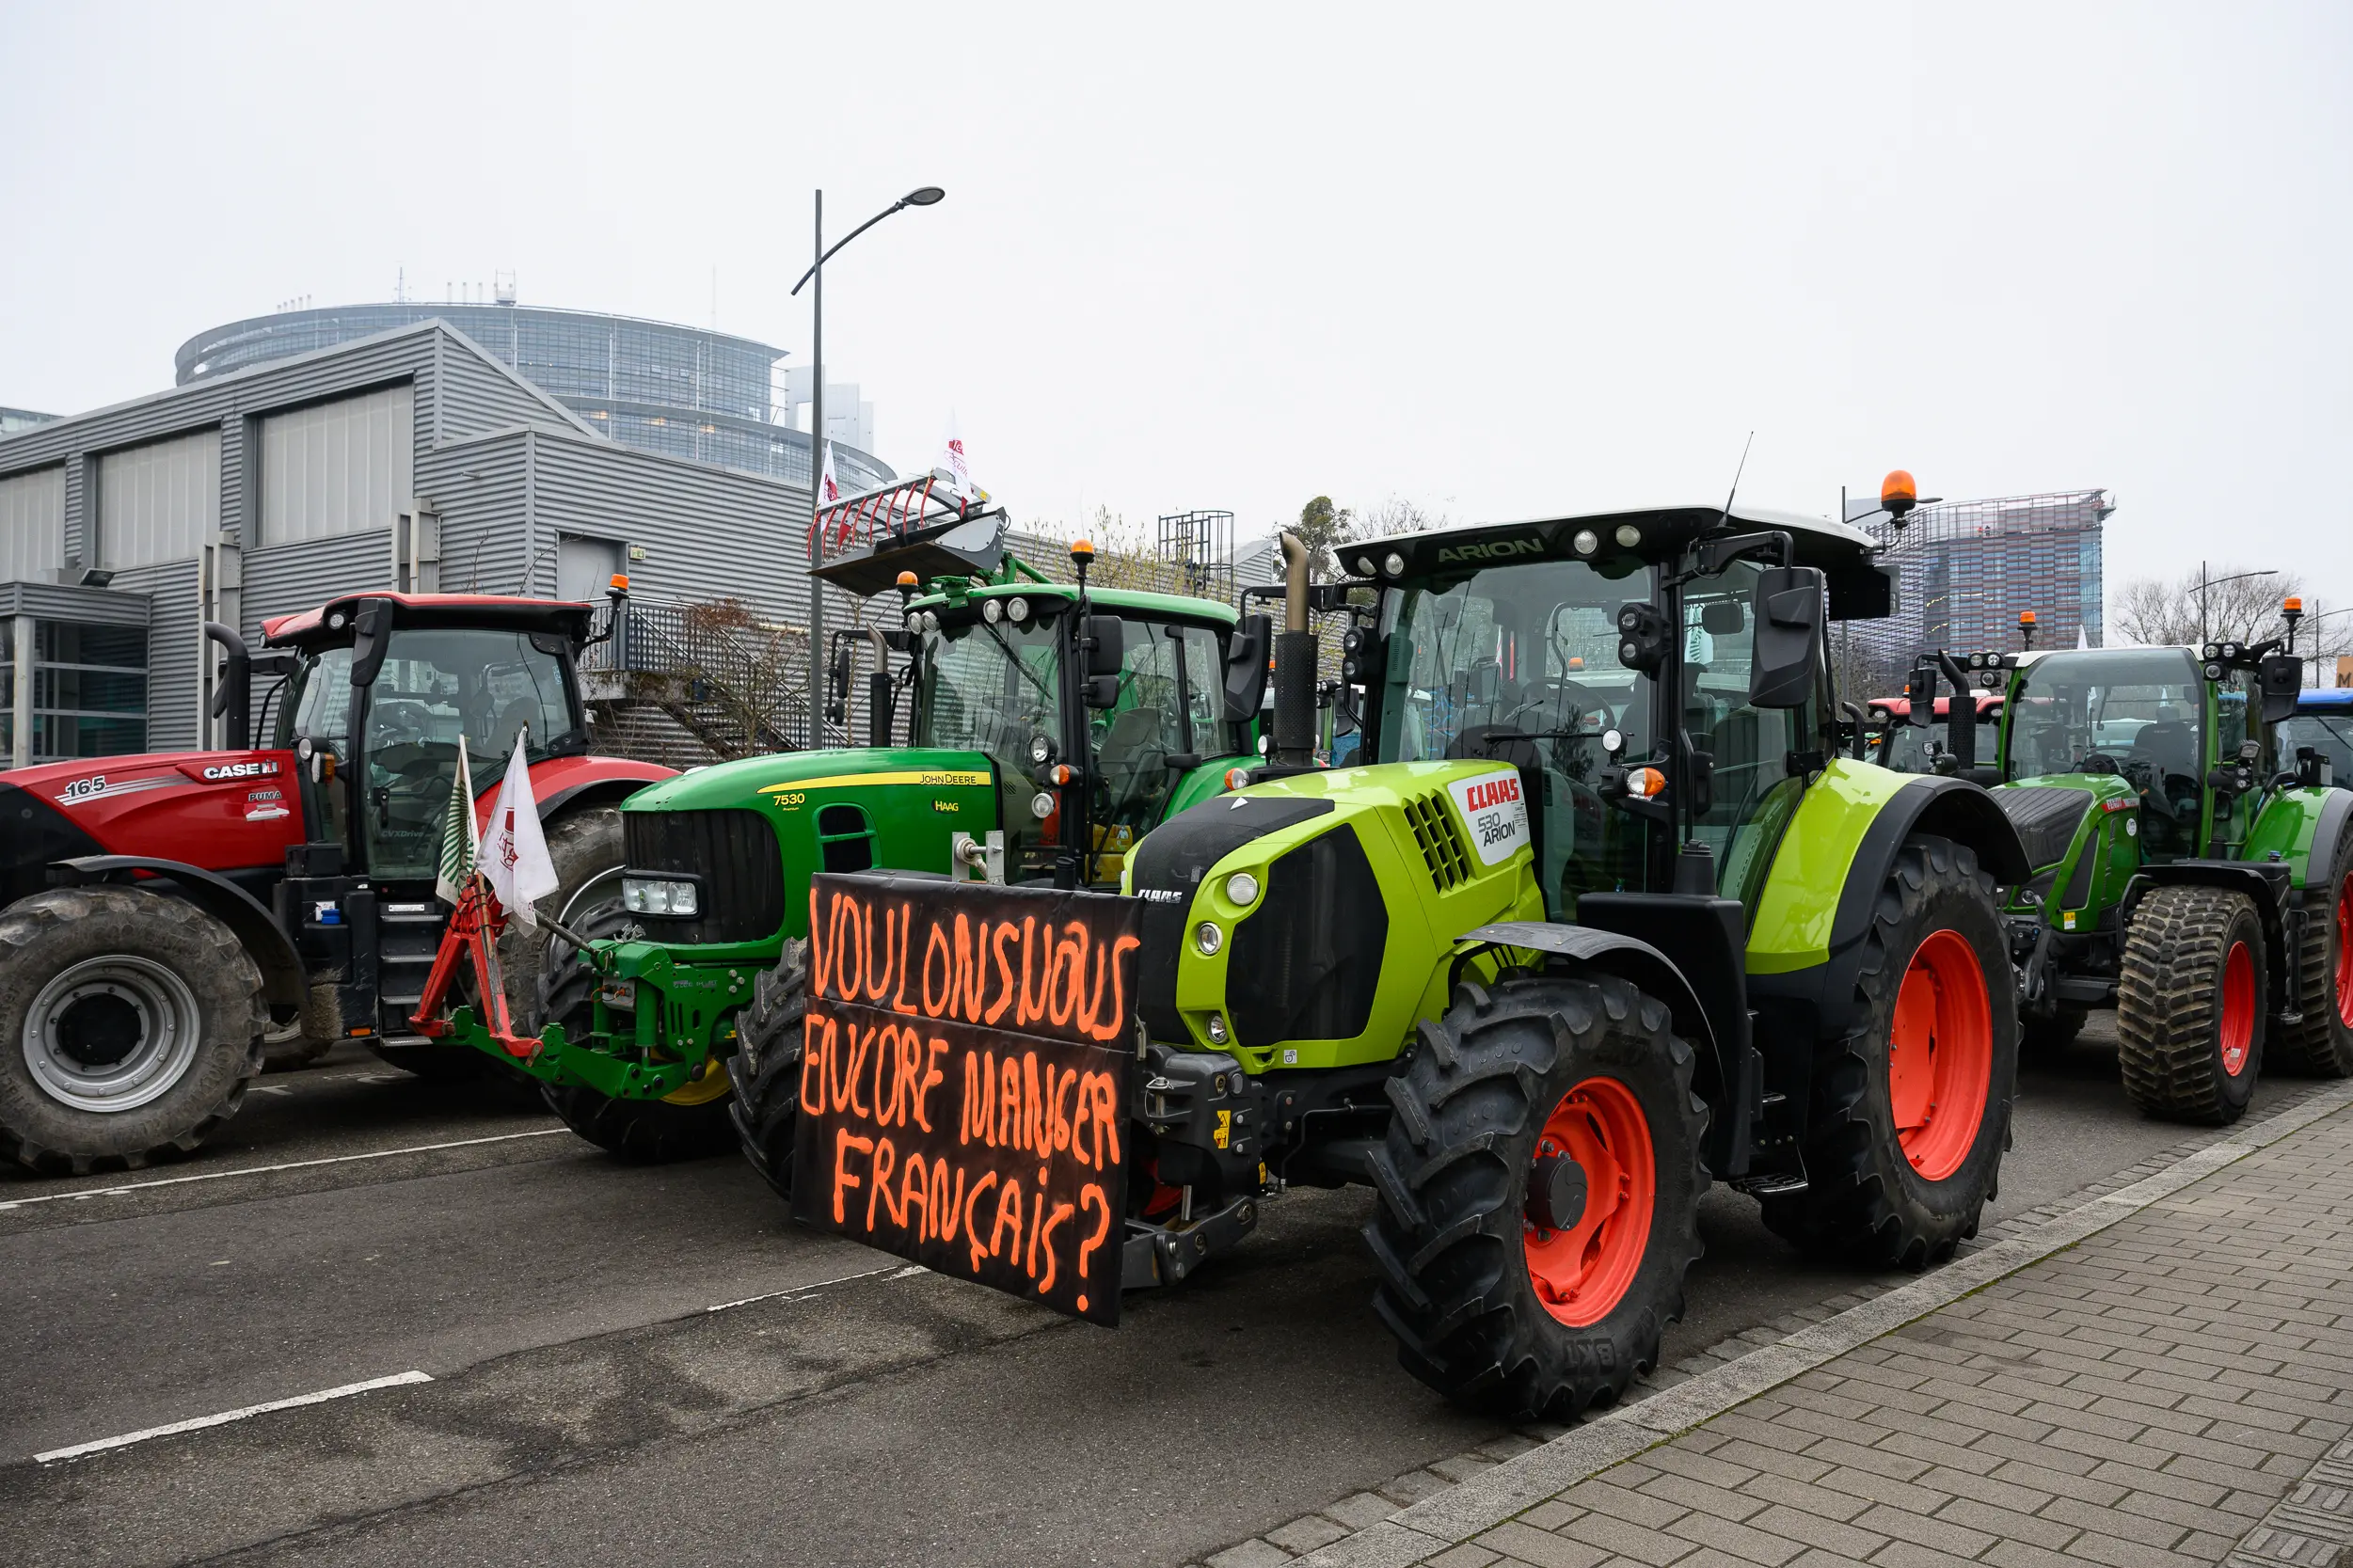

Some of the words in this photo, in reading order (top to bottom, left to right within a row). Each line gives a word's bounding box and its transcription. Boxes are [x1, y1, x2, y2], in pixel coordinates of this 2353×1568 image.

[1439, 538, 1545, 562] ARION
[203, 764, 260, 780] CASE
[66, 775, 106, 798] 165
[248, 790, 282, 802] PUMA
[1467, 778, 1519, 813] CLAAS
[773, 793, 805, 806] 7530
[934, 800, 959, 812] HAAG
[1477, 812, 1501, 833] 530
[1484, 821, 1516, 847] ARION
[1138, 889, 1183, 903] CLAAS
[802, 1014, 948, 1132] ENCORE
[960, 1051, 1121, 1171] MANGER
